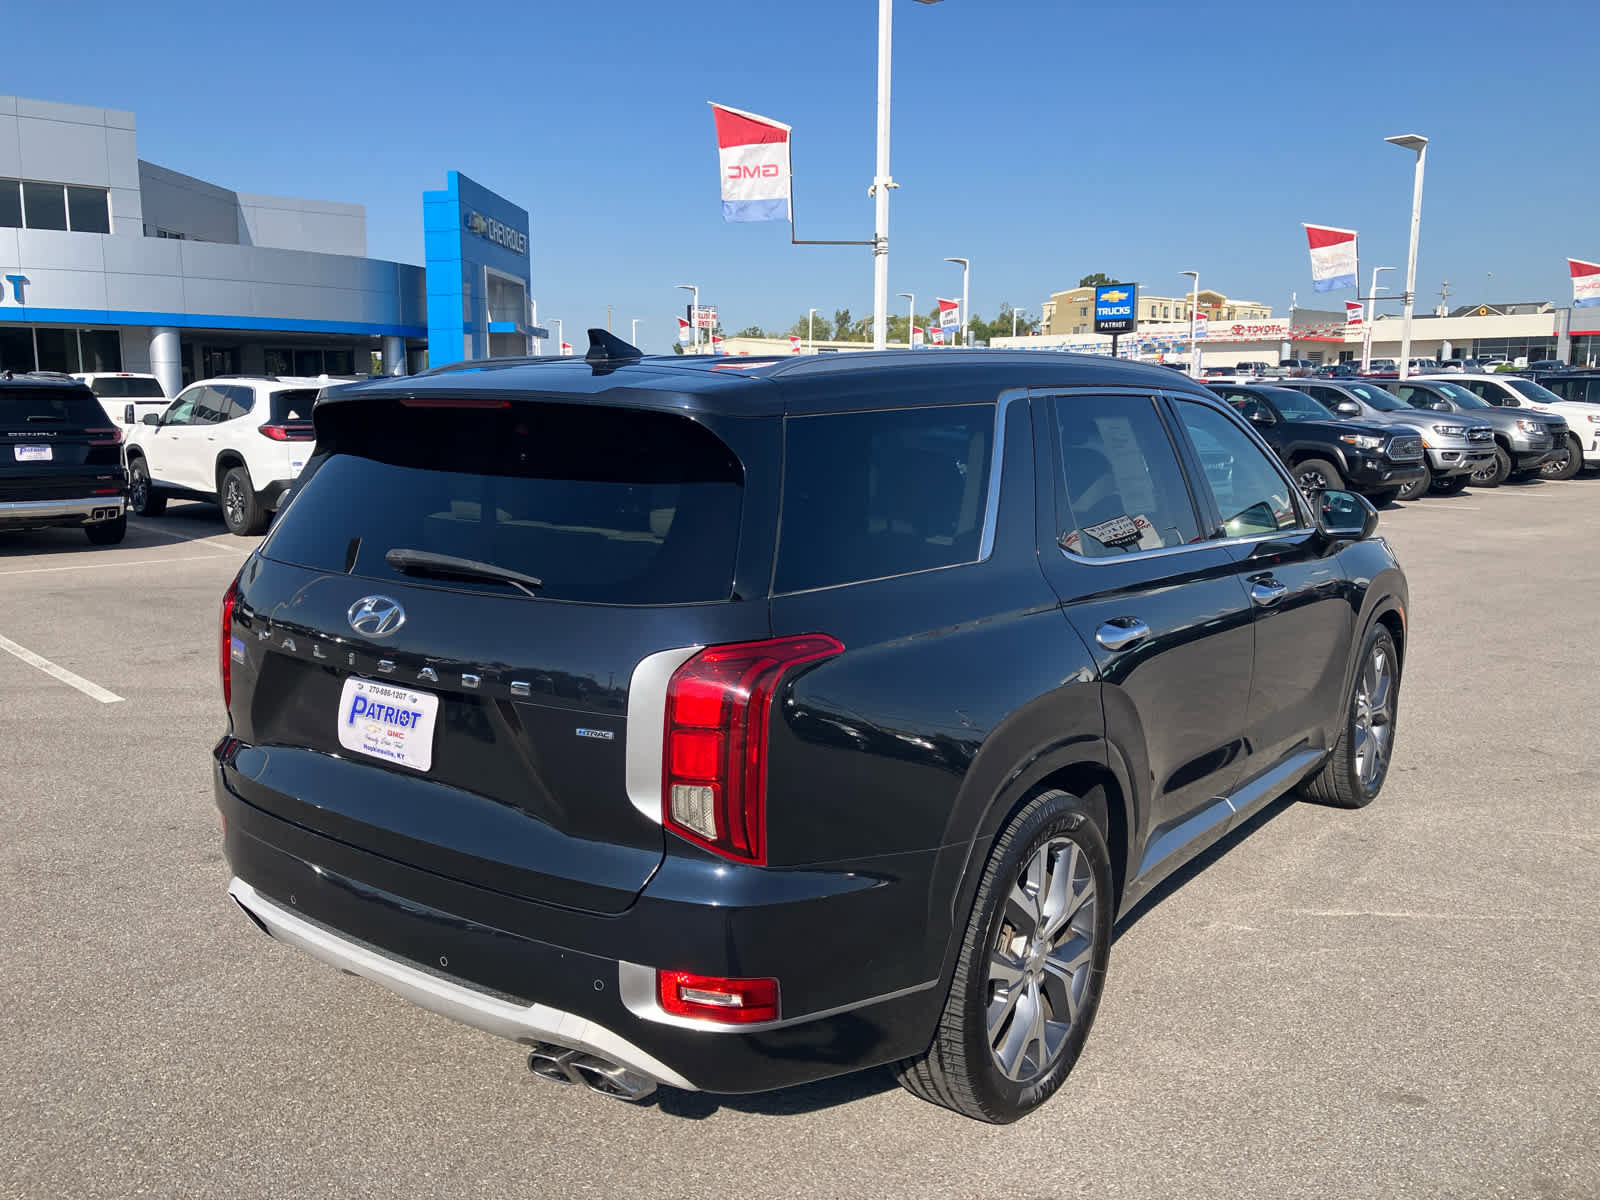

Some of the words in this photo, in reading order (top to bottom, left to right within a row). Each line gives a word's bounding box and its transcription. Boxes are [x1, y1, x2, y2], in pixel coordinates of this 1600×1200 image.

[487, 217, 527, 256] CHEVROLET
[1097, 306, 1131, 316] TRUCKS
[1101, 321, 1126, 329] PATRIOT
[1247, 324, 1282, 334] TOYOTA
[258, 629, 532, 697] PALISADE
[349, 695, 422, 729] PATRIOT
[387, 730, 405, 739] GMC
[397, 752, 405, 760] KY
